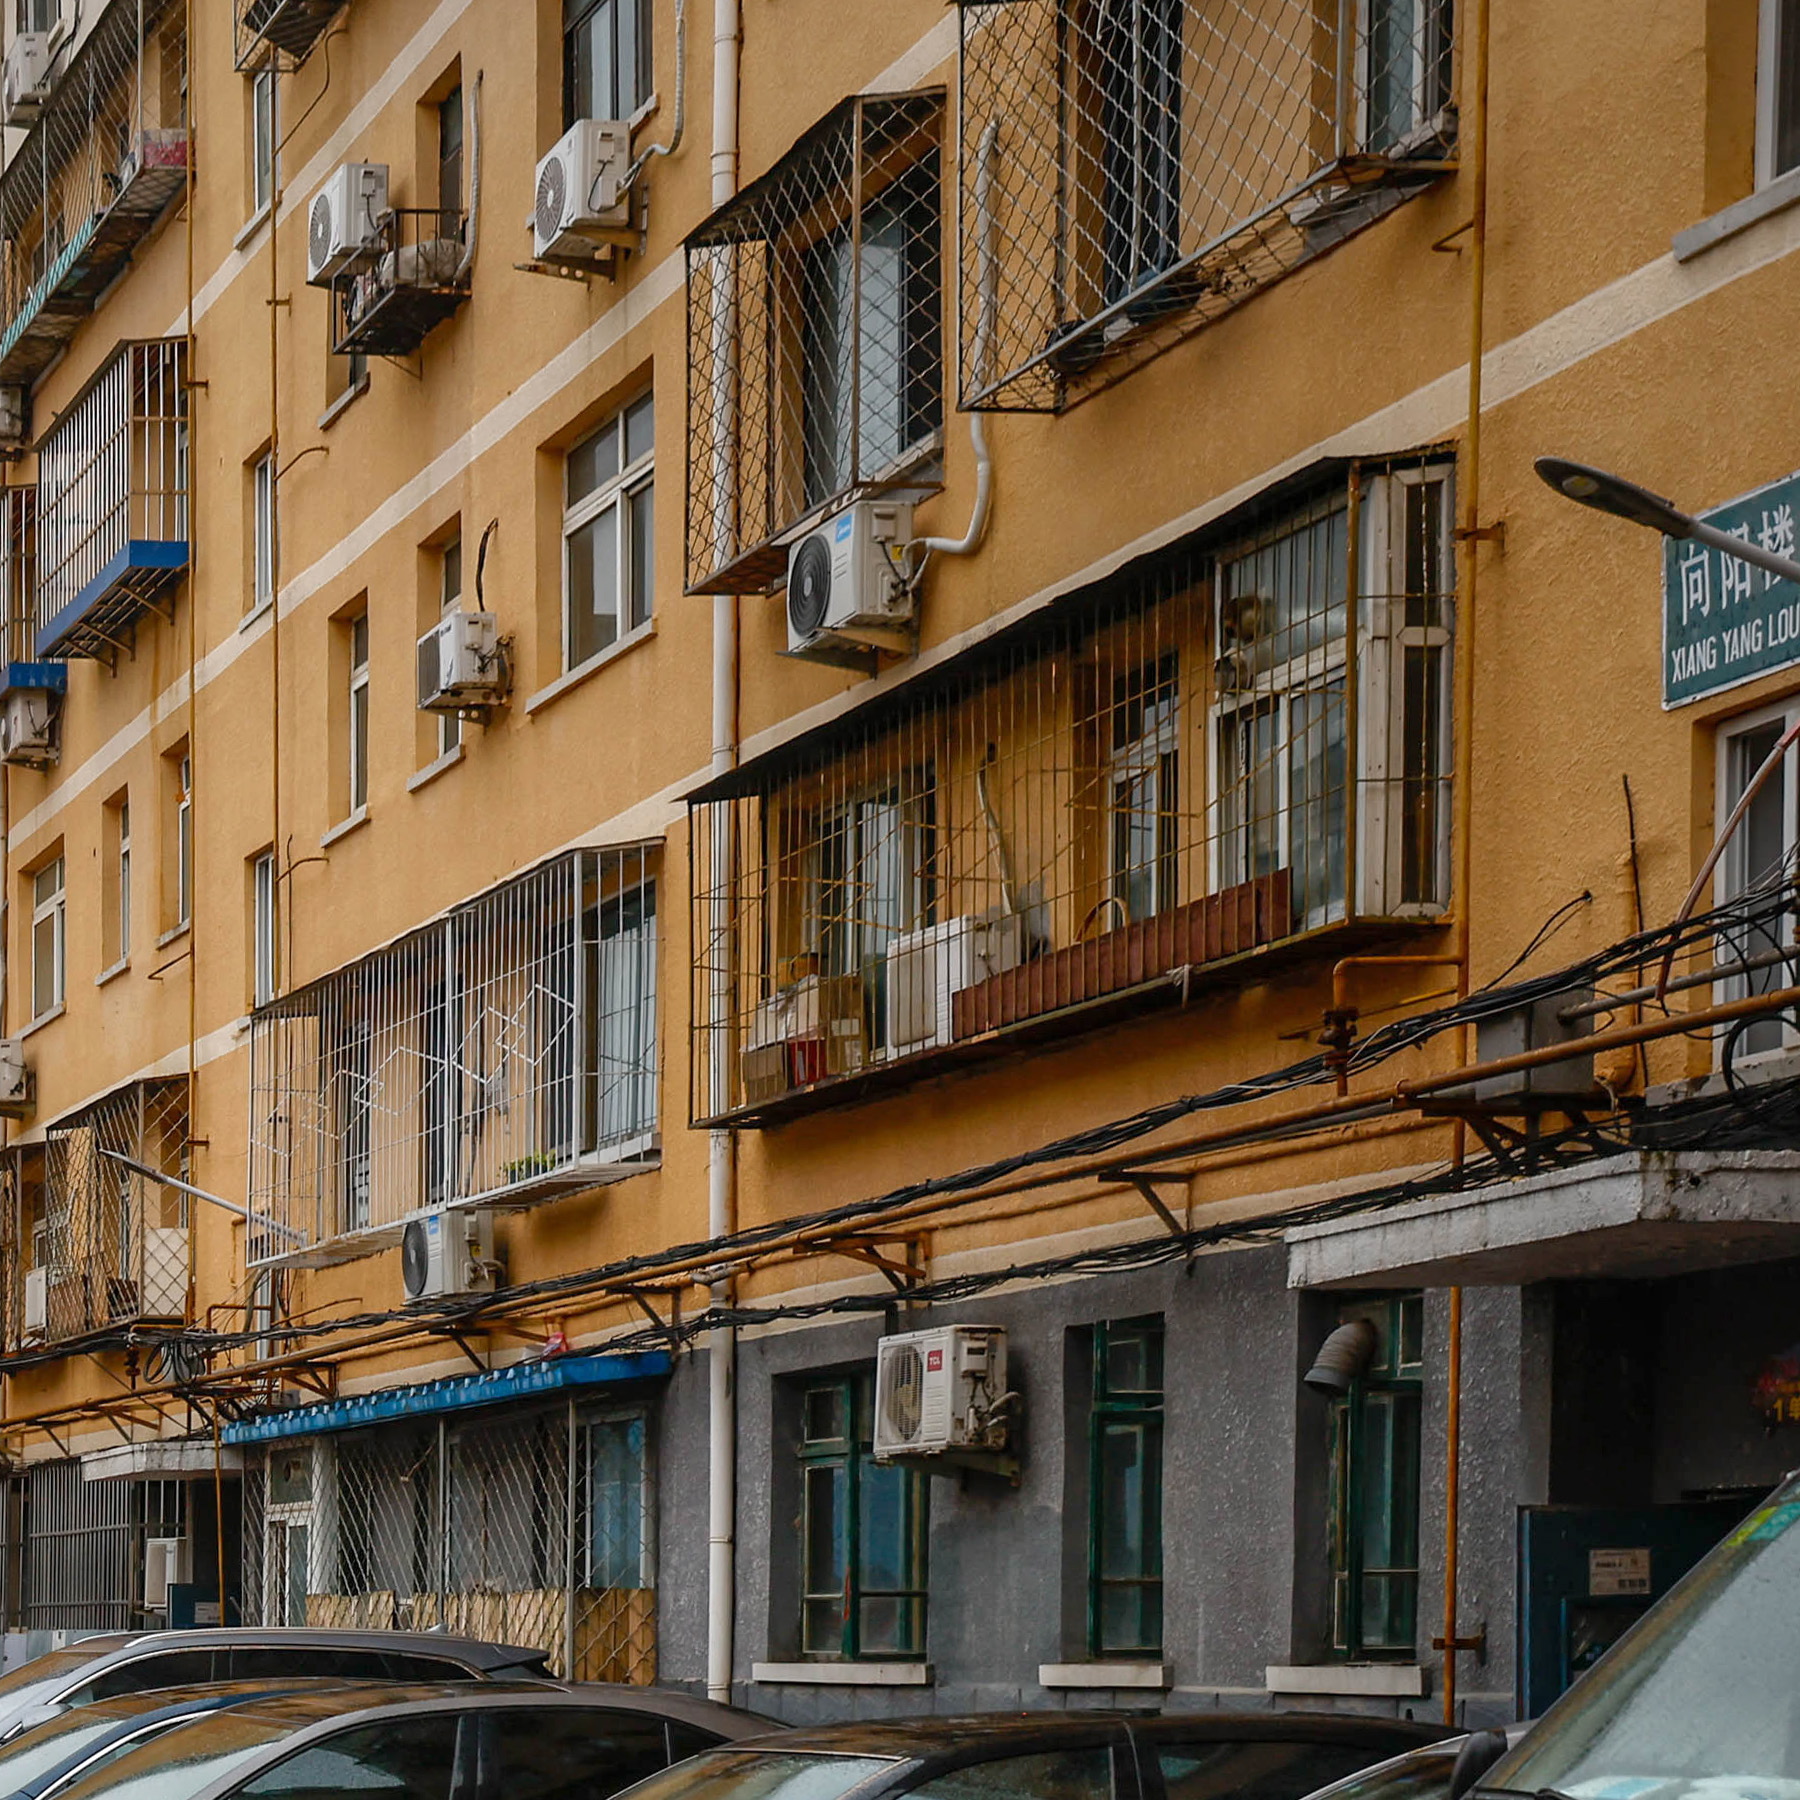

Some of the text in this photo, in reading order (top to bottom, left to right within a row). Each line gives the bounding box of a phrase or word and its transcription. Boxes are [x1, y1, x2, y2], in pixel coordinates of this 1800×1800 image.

[1680, 503, 1795, 626] 向阳楼
[1671, 601, 1800, 684] XIANG YANG LOU
